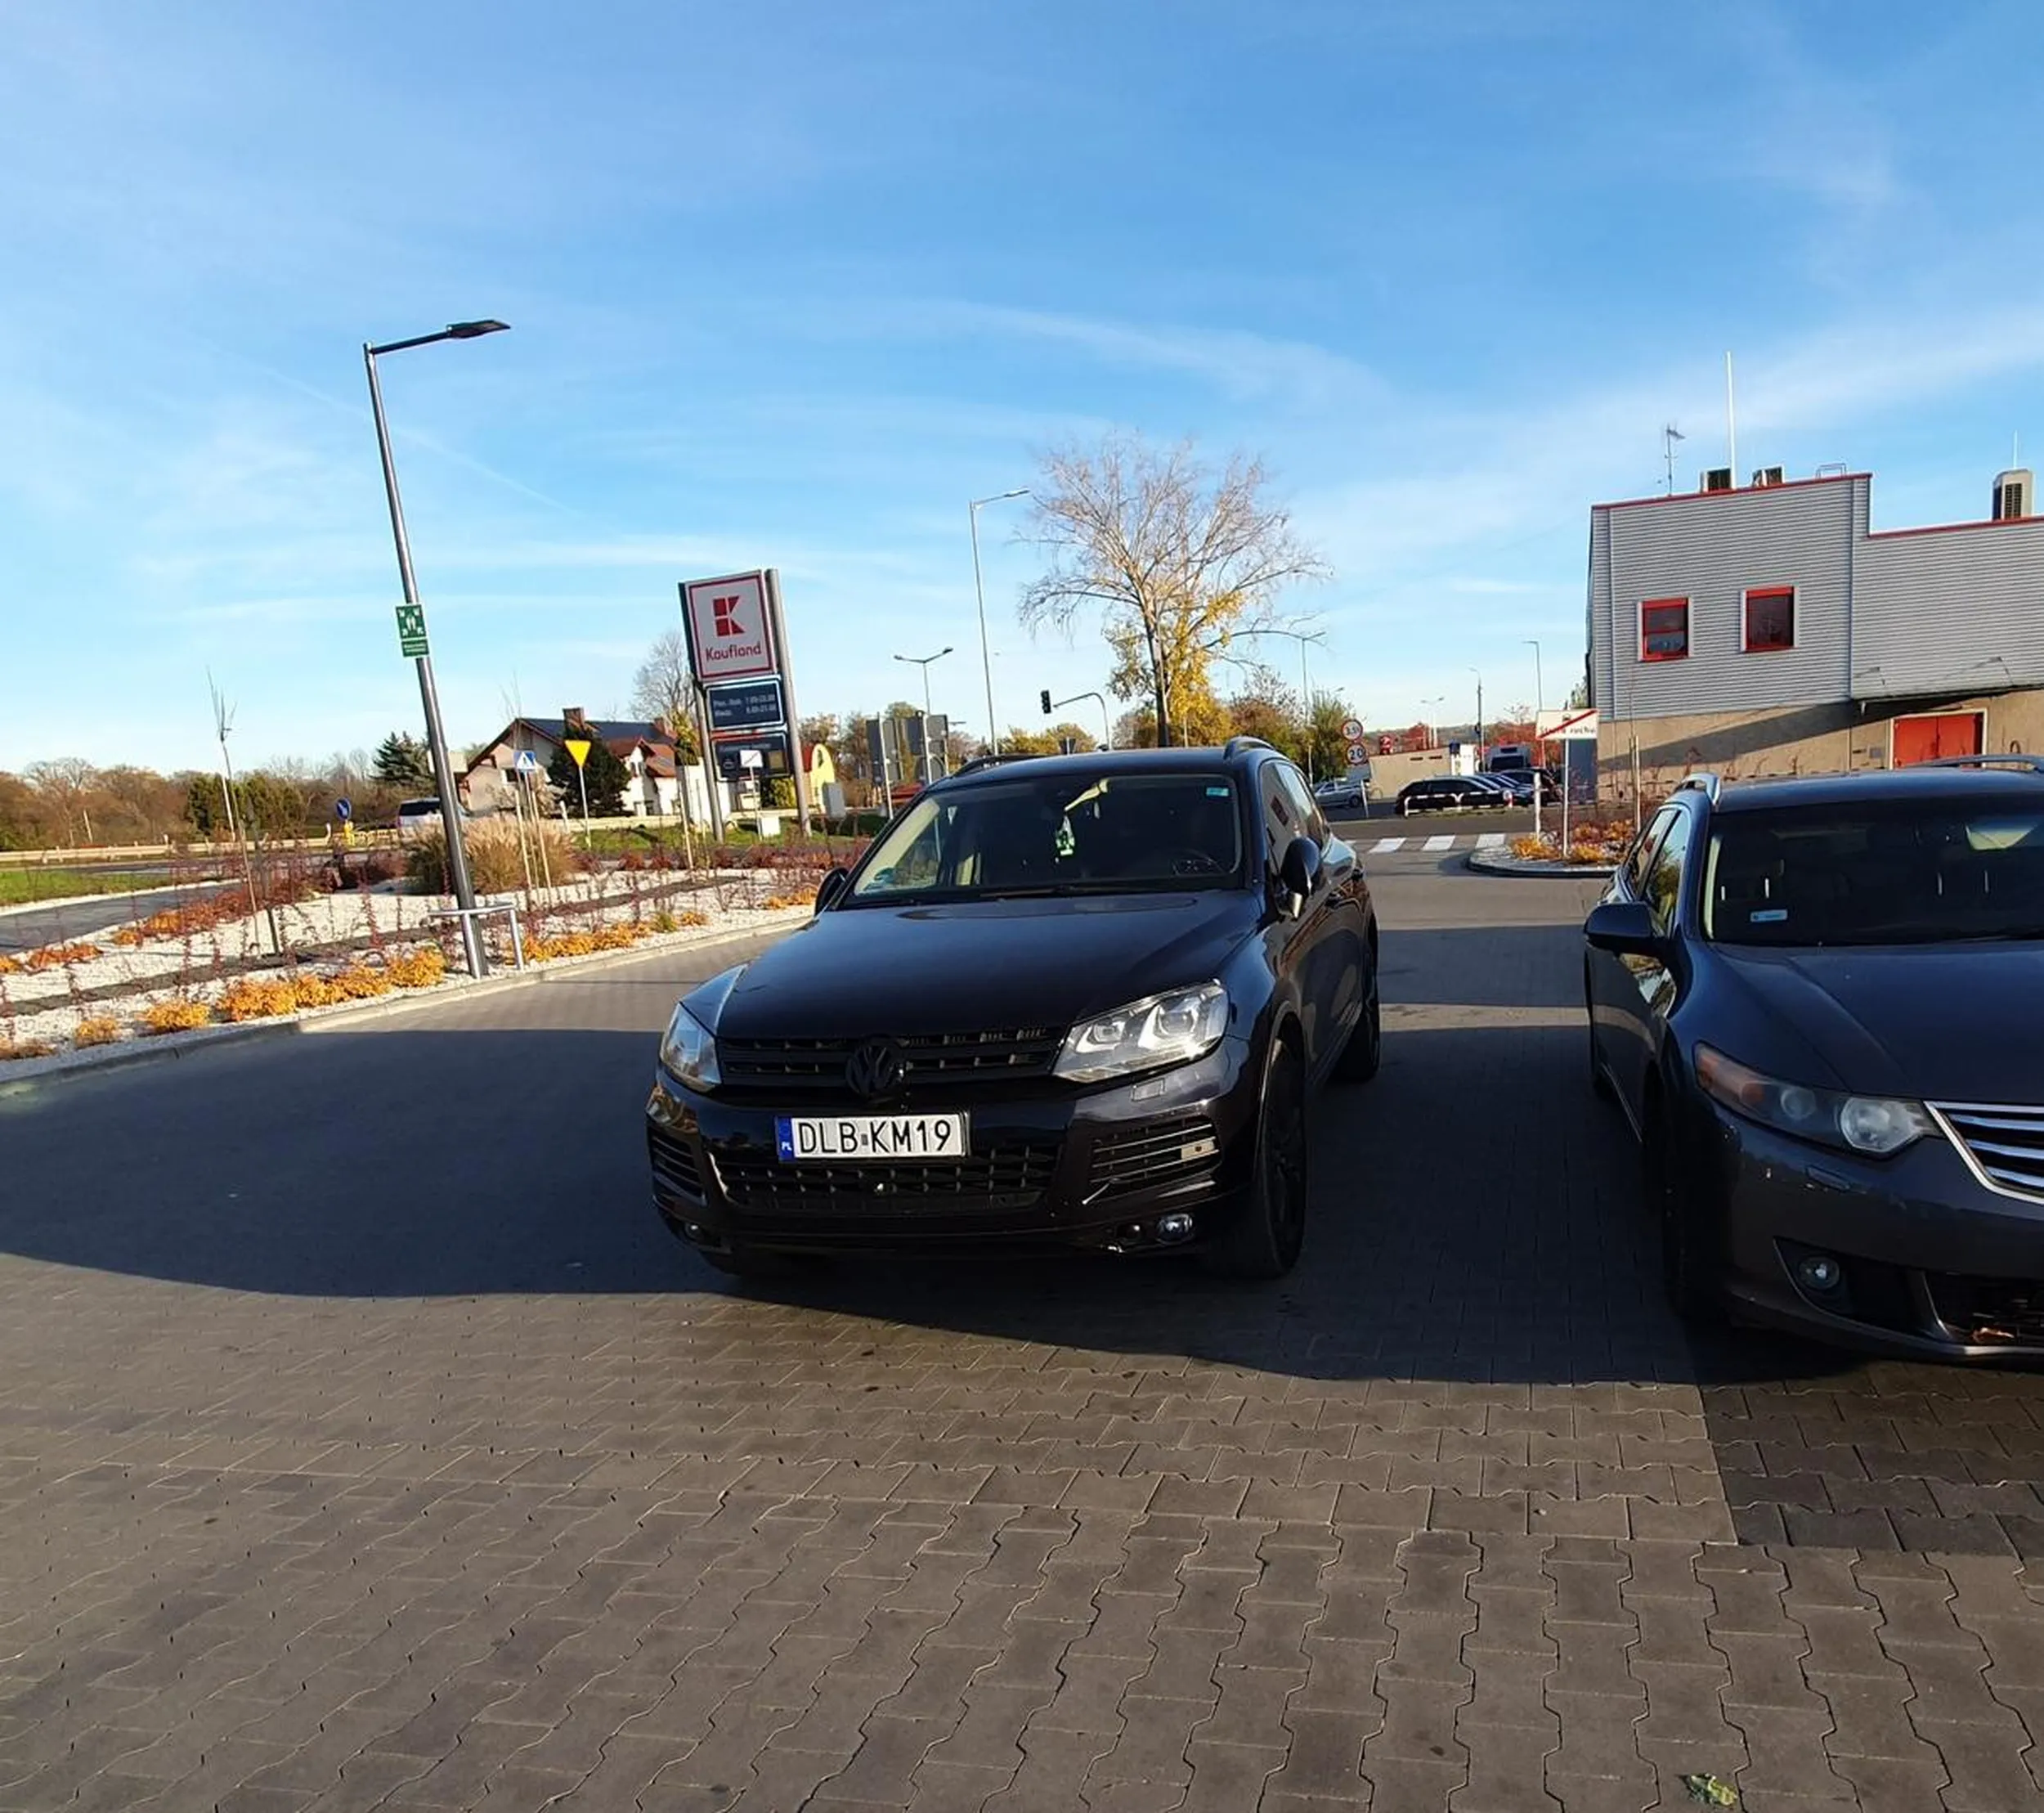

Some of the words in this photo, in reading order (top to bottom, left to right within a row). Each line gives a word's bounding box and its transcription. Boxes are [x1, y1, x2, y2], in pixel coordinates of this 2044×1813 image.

[705, 641, 762, 661] Kaufland
[798, 1122, 858, 1154] DLB
[869, 1120, 952, 1153] KM19
